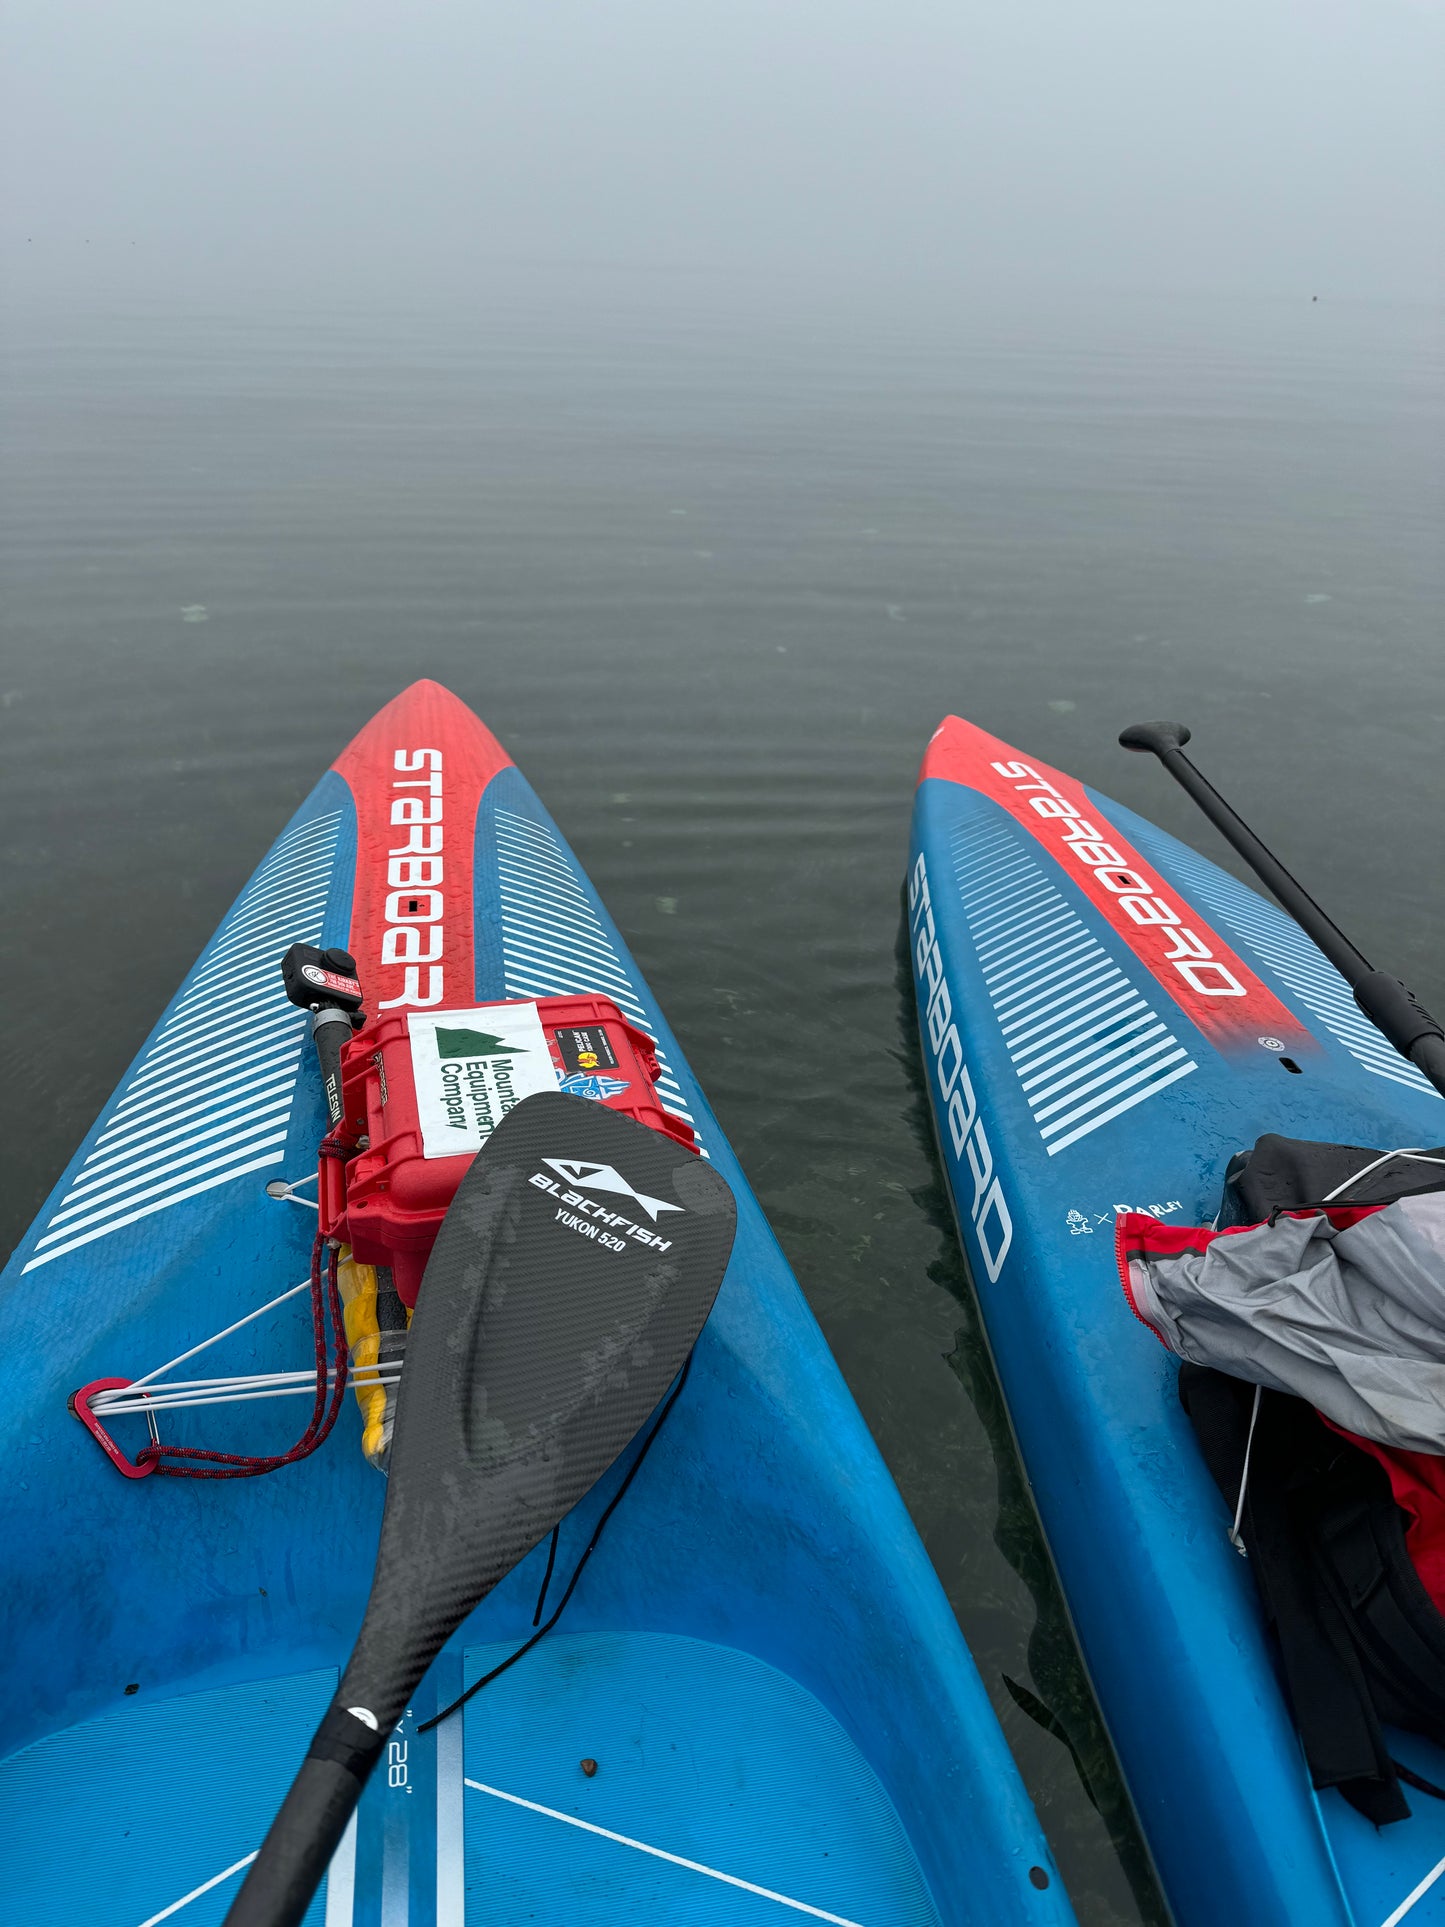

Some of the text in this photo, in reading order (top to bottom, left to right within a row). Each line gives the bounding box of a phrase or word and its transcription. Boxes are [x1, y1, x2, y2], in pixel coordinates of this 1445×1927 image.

[378, 748, 443, 1018] STARBOAR
[990, 761, 1247, 997] STARBOARD
[325, 1073, 341, 1123] TELESIN
[440, 1063, 468, 1130] Company
[491, 1059, 520, 1117] Mounta
[910, 852, 1013, 1284] STARBOARD
[554, 1208, 627, 1252] YUKON 520
